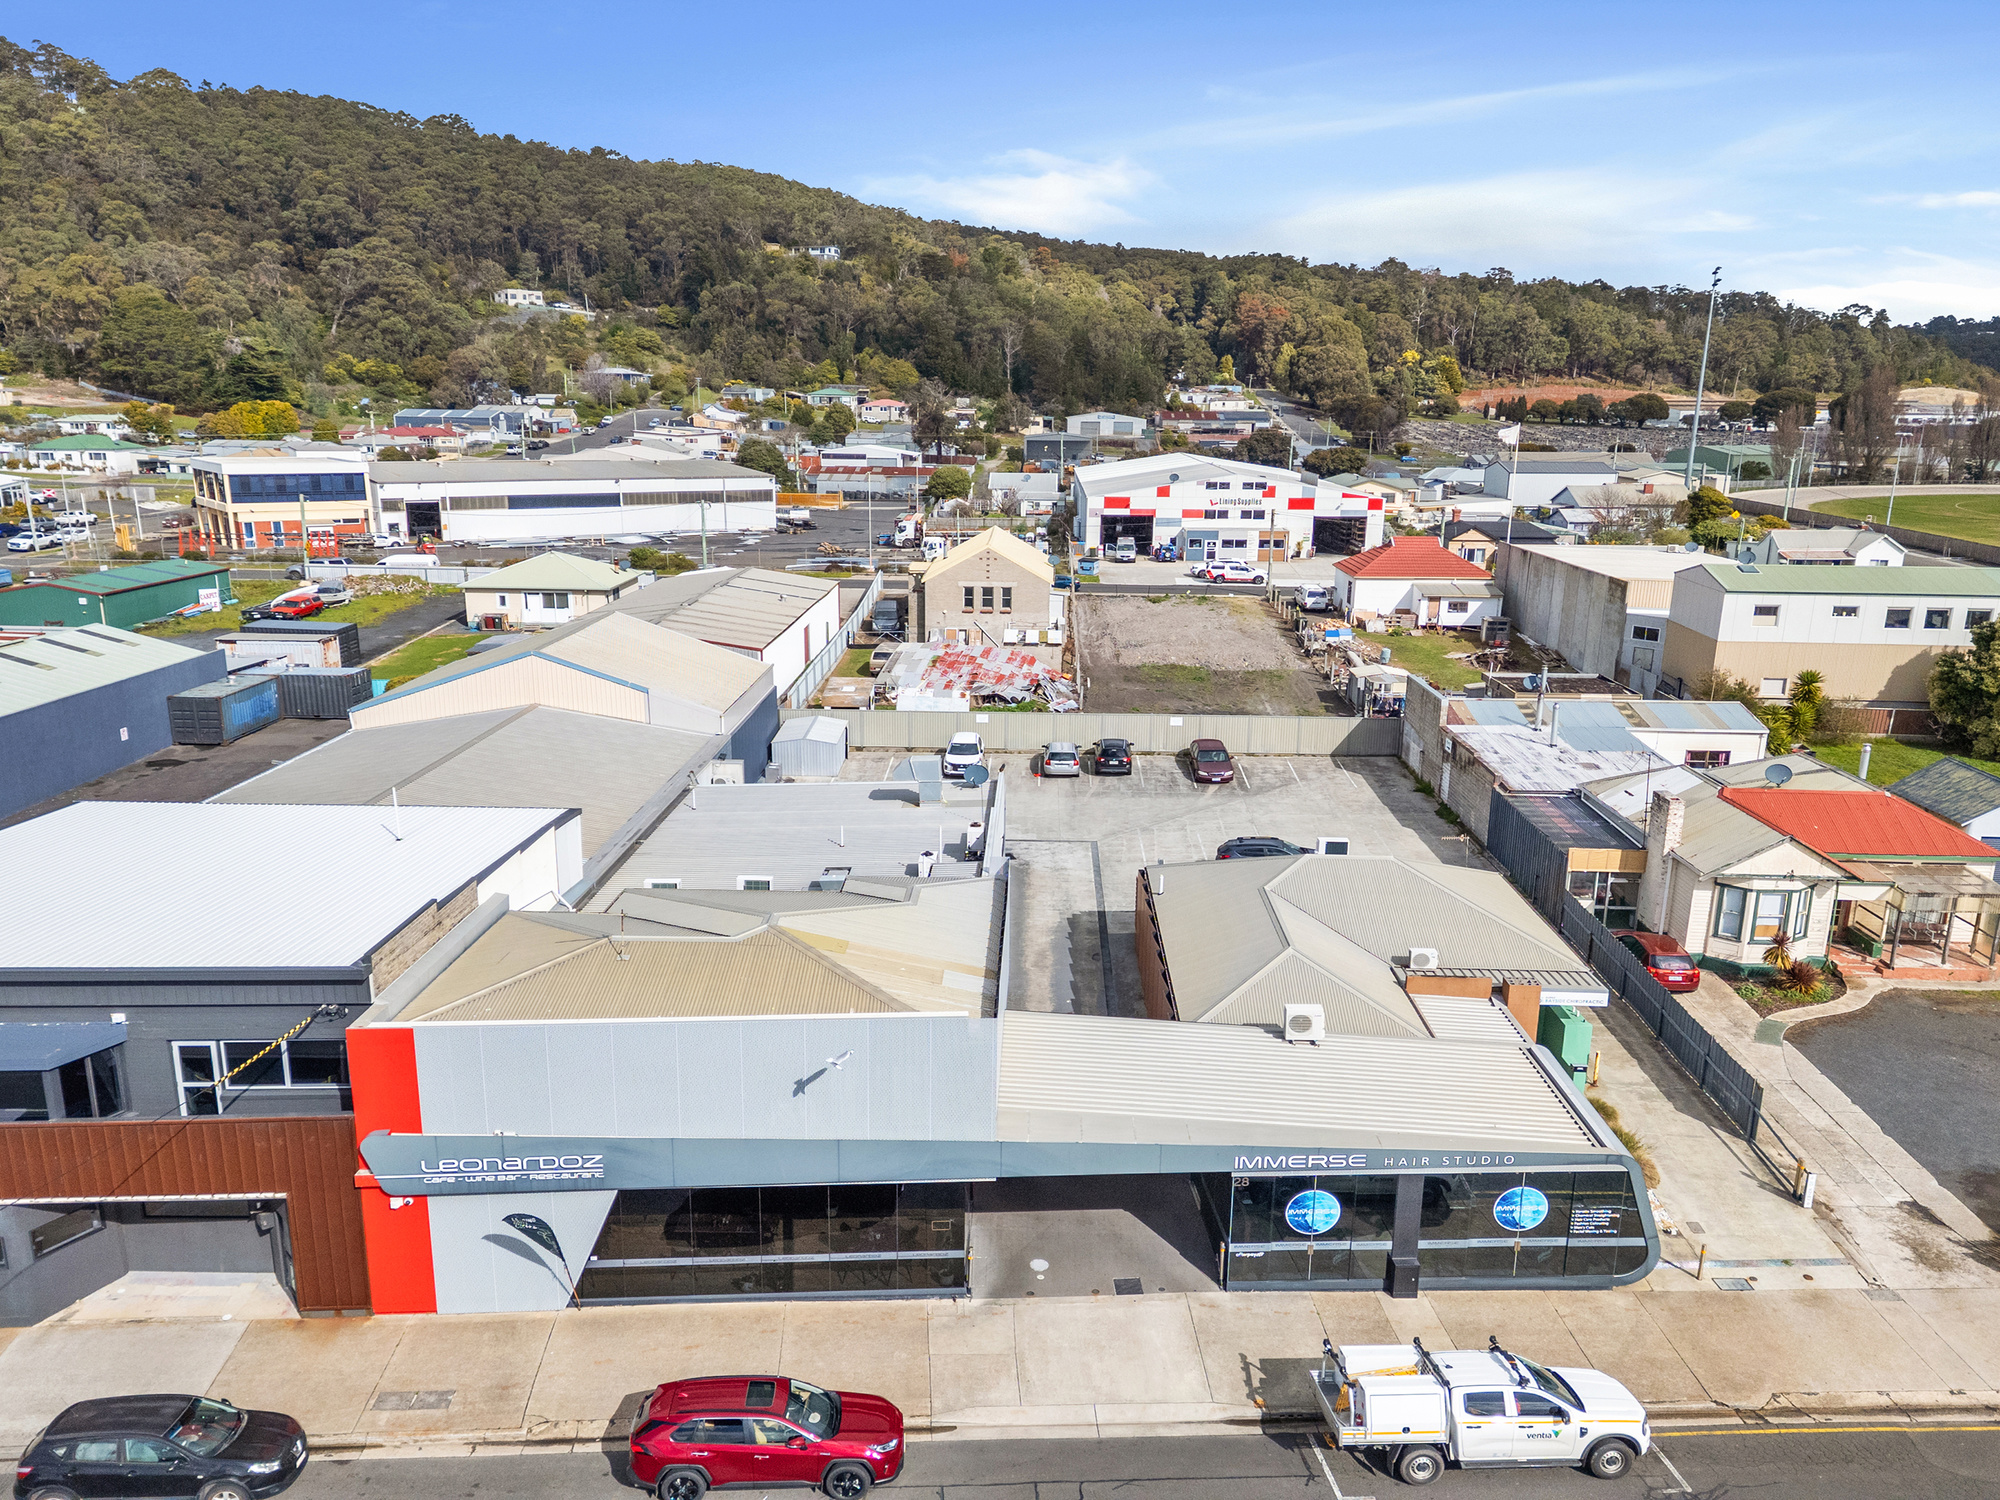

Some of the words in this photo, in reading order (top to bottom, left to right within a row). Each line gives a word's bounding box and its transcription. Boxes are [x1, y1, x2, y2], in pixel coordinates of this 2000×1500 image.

[1234, 1154, 1367, 1169] IMMERSE
[1384, 1157, 1430, 1167] HAIR
[1442, 1155, 1515, 1166] STUDIO
[1233, 1177, 1250, 1187] 28
